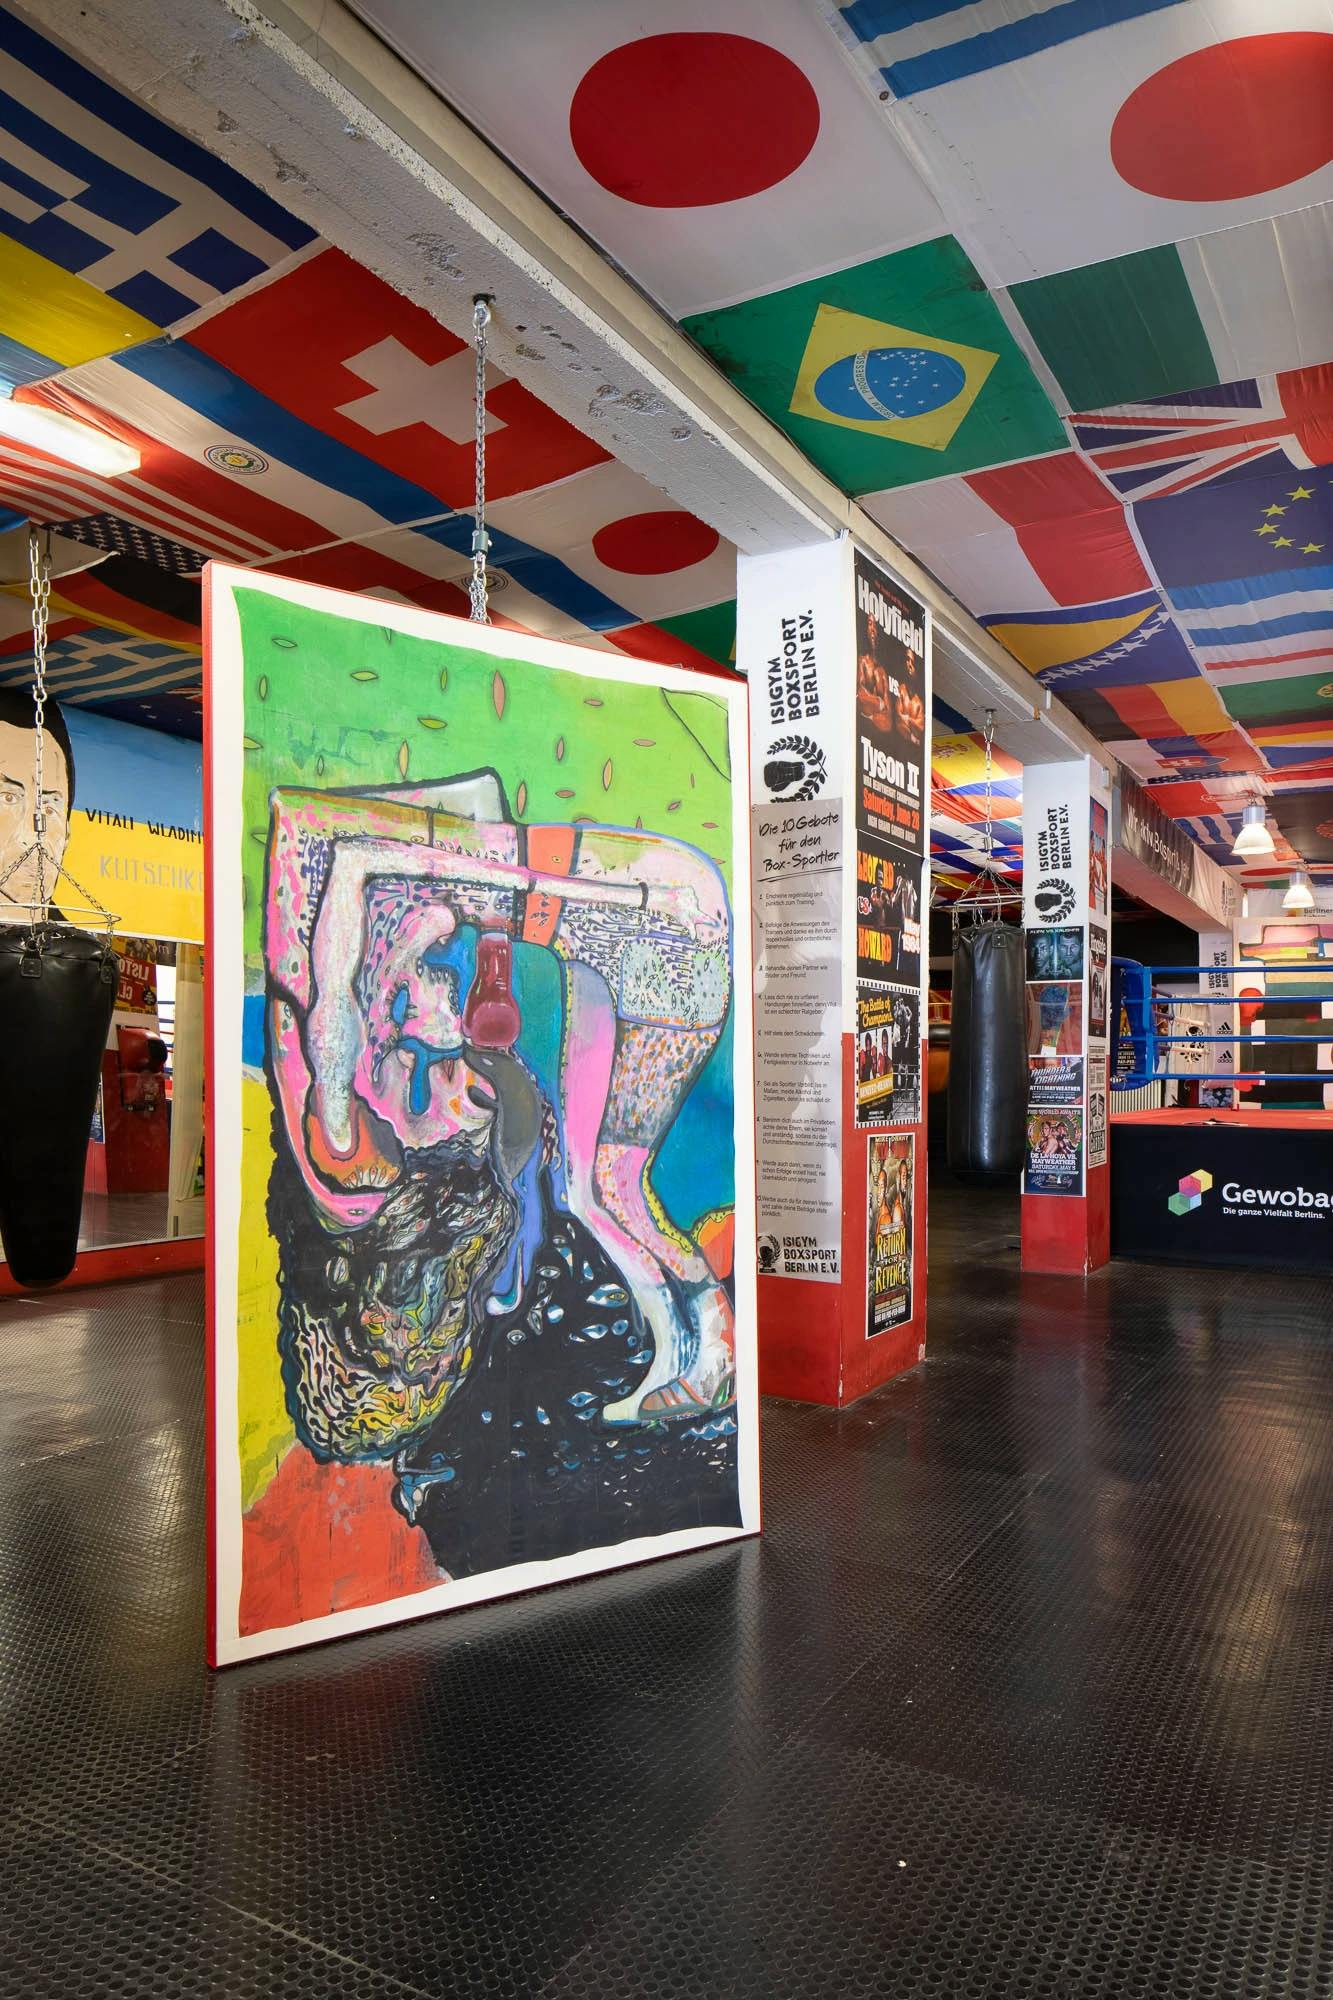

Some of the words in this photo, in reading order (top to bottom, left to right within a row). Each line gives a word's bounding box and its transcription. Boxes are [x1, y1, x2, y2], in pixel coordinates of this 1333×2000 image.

[856, 356, 870, 394] PROGRESSO
[798, 610, 814, 642] E.V.
[858, 574, 924, 658] Holyfield
[782, 618, 802, 721] BOXSPORT
[801, 647, 820, 718] BERLIN
[768, 656, 785, 724] ISIGYM
[861, 736, 905, 790] Tyson
[907, 761, 920, 798] II
[85, 808, 134, 830] VITALI
[759, 823, 778, 836] Die
[781, 818, 795, 834] 10
[796, 812, 839, 830] Gebote
[864, 787, 896, 821] Saturday,
[896, 803, 911, 827] June
[1059, 804, 1069, 824] E.V.
[778, 838, 797, 853] für
[800, 834, 821, 846] den
[1038, 830, 1050, 872] ISIGYM
[1048, 808, 1060, 870] BOXSPORT
[1060, 826, 1072, 868] BERLIN
[763, 850, 840, 872] Box-Sportler
[858, 927, 892, 963] HOWARD
[858, 1000, 869, 1014] The
[869, 996, 884, 1011] Battle
[885, 996, 890, 1011] of
[1223, 1207, 1237, 1215] Die
[1238, 1208, 1262, 1217] ganze
[1264, 1208, 1293, 1218] Vielfalt
[1294, 1210, 1325, 1219] Berlins.
[782, 1236, 817, 1248] ISIGYM
[784, 1249, 836, 1260] BOXSPORT
[877, 1227, 906, 1261] RETURN
[784, 1261, 818, 1273] BERLIN
[821, 1262, 840, 1273] E.V.
[875, 1260, 906, 1294] REVENGE
